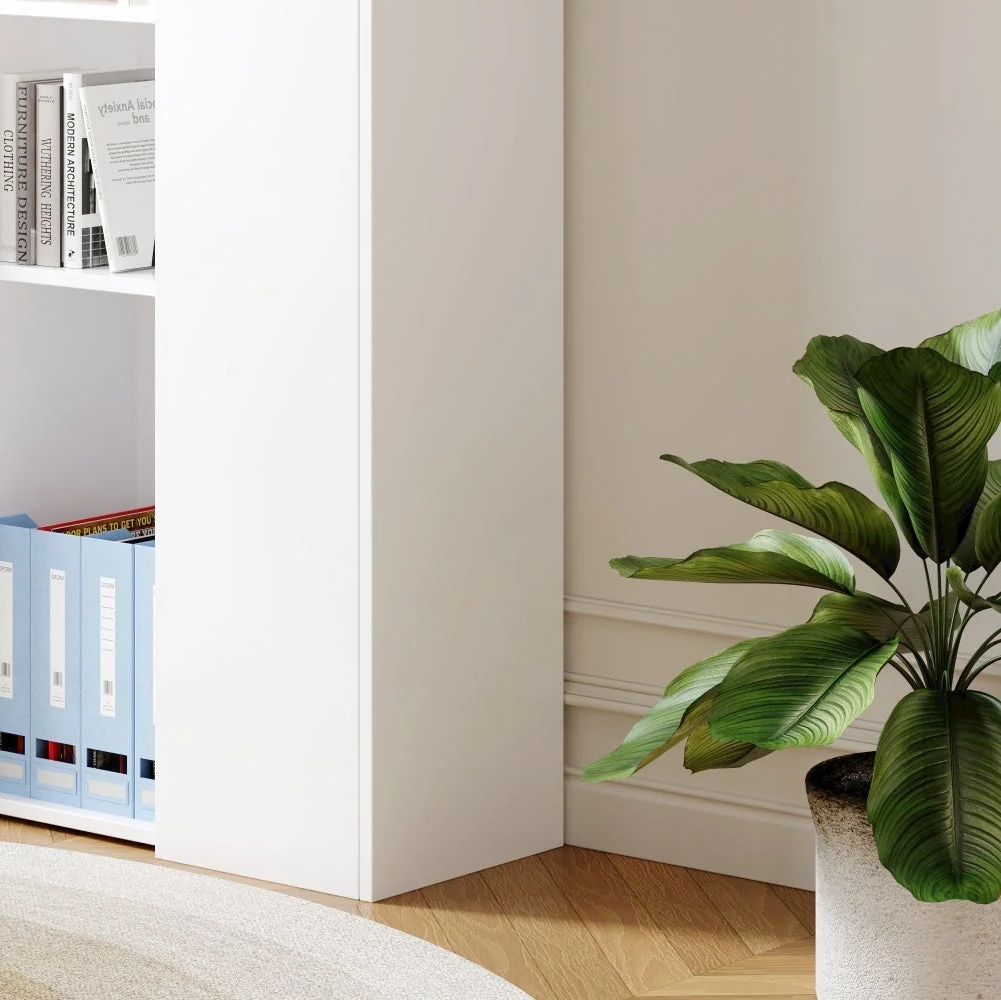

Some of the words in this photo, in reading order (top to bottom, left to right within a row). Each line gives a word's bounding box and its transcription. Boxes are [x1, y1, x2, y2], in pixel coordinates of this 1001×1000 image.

[3, 130, 14, 192] CLOTHING
[18, 87, 27, 190] FURNITURE
[67, 113, 75, 158] MODERN
[40, 139, 51, 198] WUTHERING
[67, 159, 75, 236] ARCHITECTURE
[18, 197, 27, 262] DESIGN
[40, 203, 51, 245] HEIGHTS
[84, 524, 107, 535] PLANS
[110, 522, 119, 530] TO
[121, 519, 134, 528] GET
